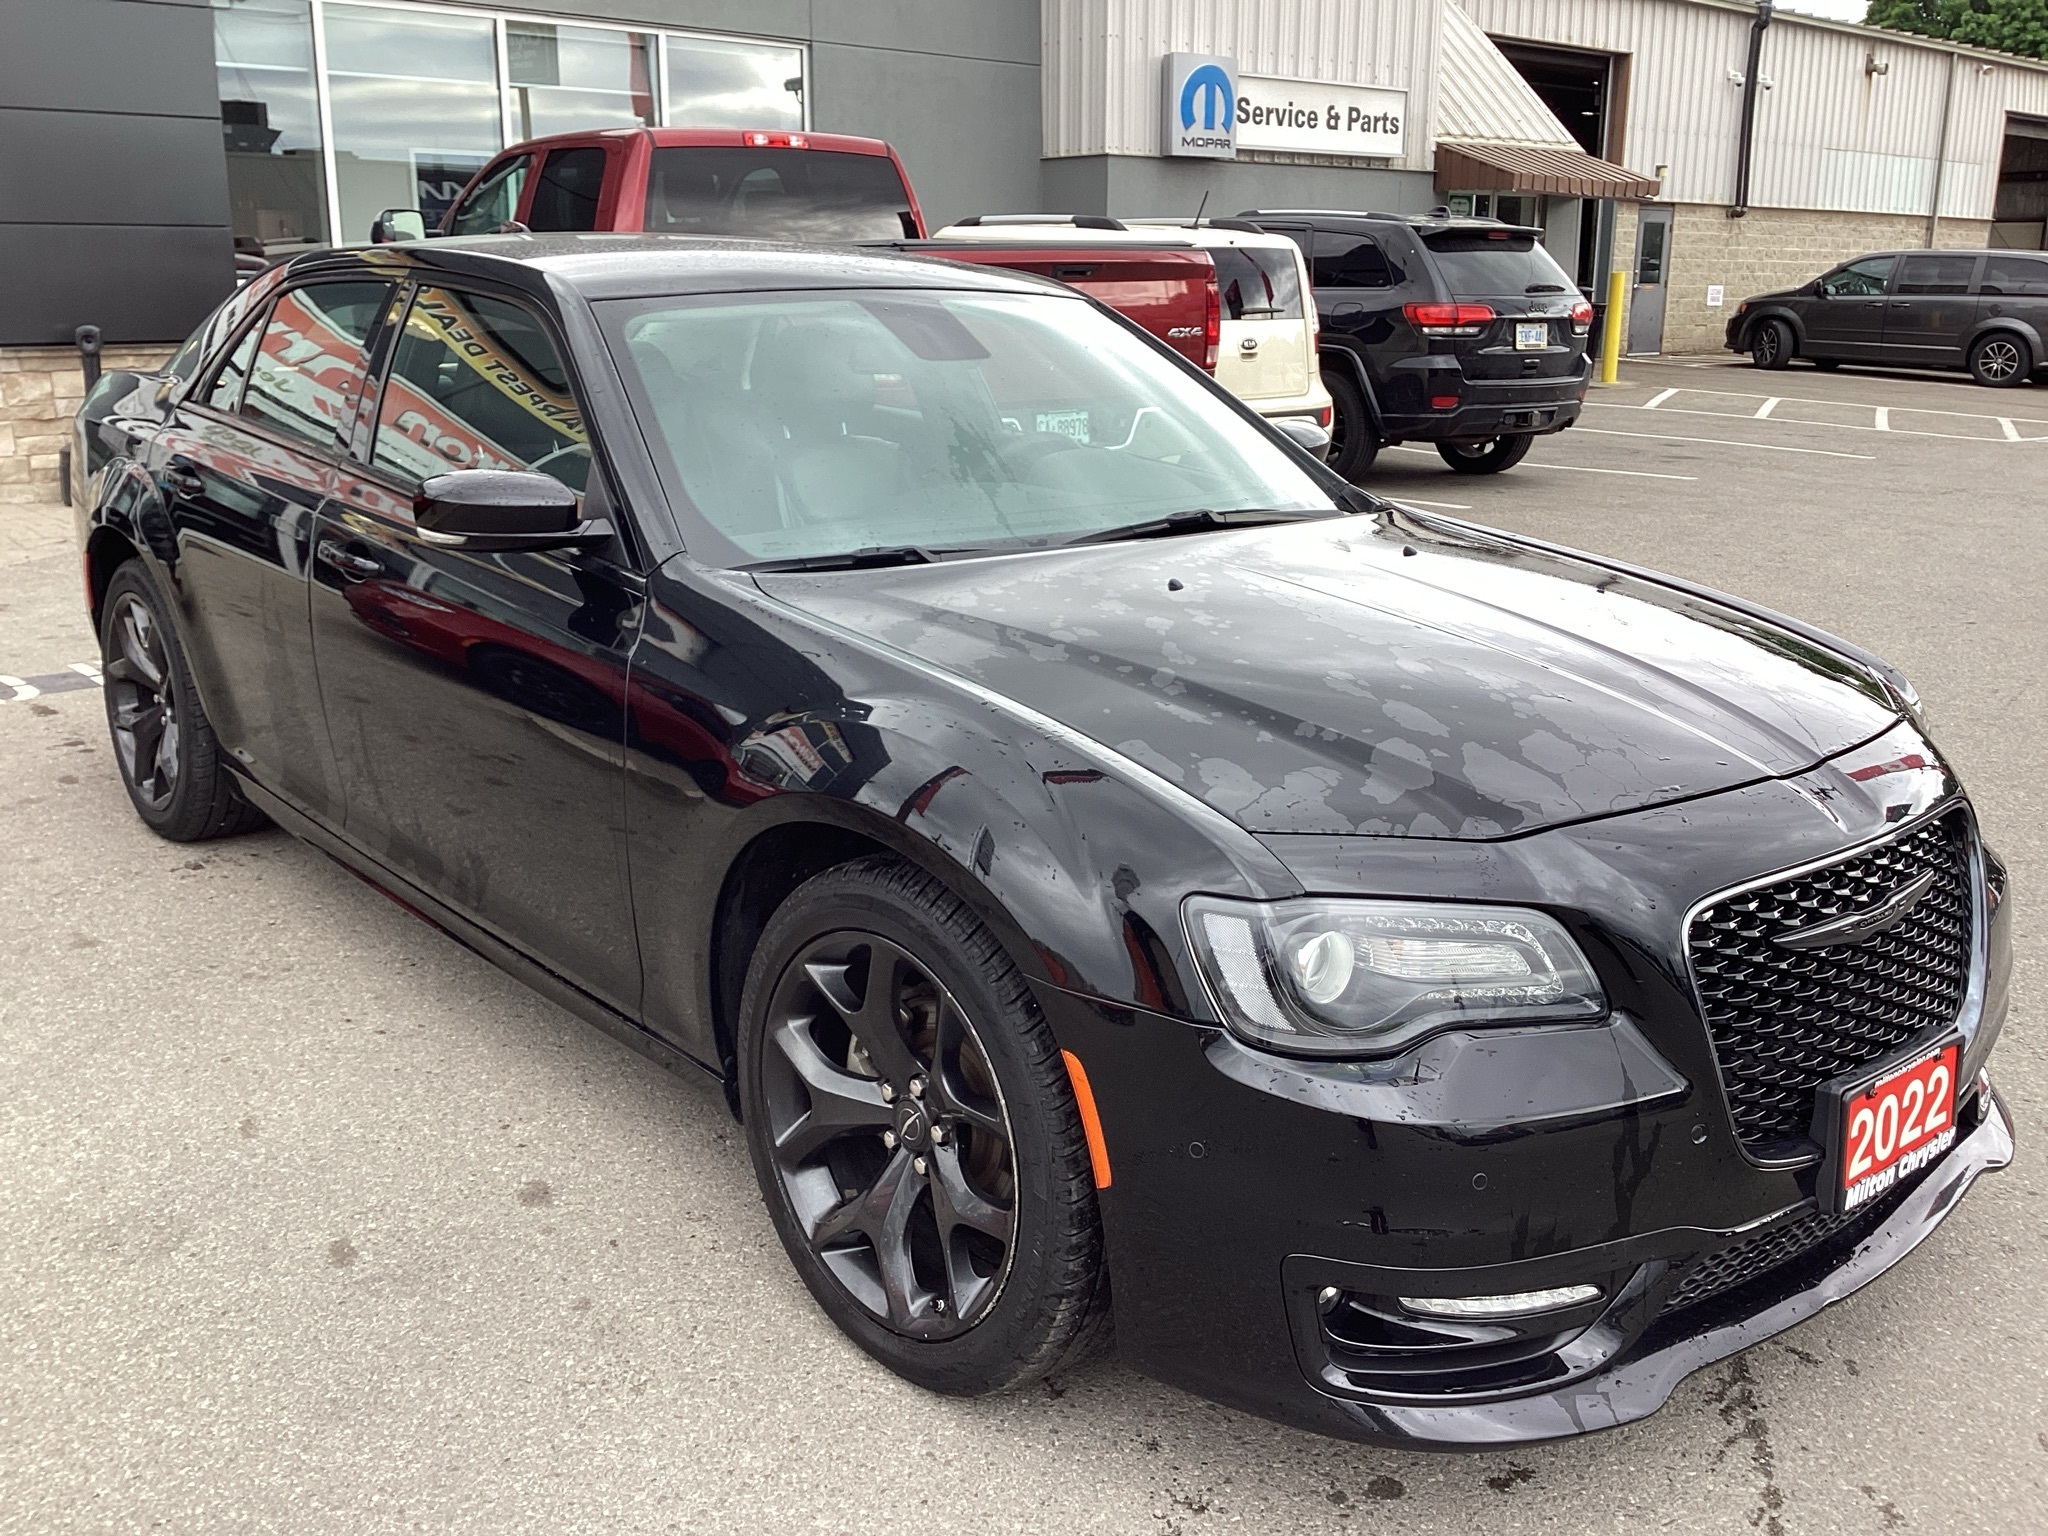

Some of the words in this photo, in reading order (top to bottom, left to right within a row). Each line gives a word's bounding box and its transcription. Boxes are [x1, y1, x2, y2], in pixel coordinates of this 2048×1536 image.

[1181, 136, 1231, 149] MOPAR
[1237, 97, 1318, 129] Service
[1326, 105, 1340, 130] &
[1347, 106, 1400, 135] Parts
[1848, 1065, 1949, 1180] 2022
[1844, 1166, 1895, 1210] Milton
[1898, 1126, 1956, 1178] Chrysler
